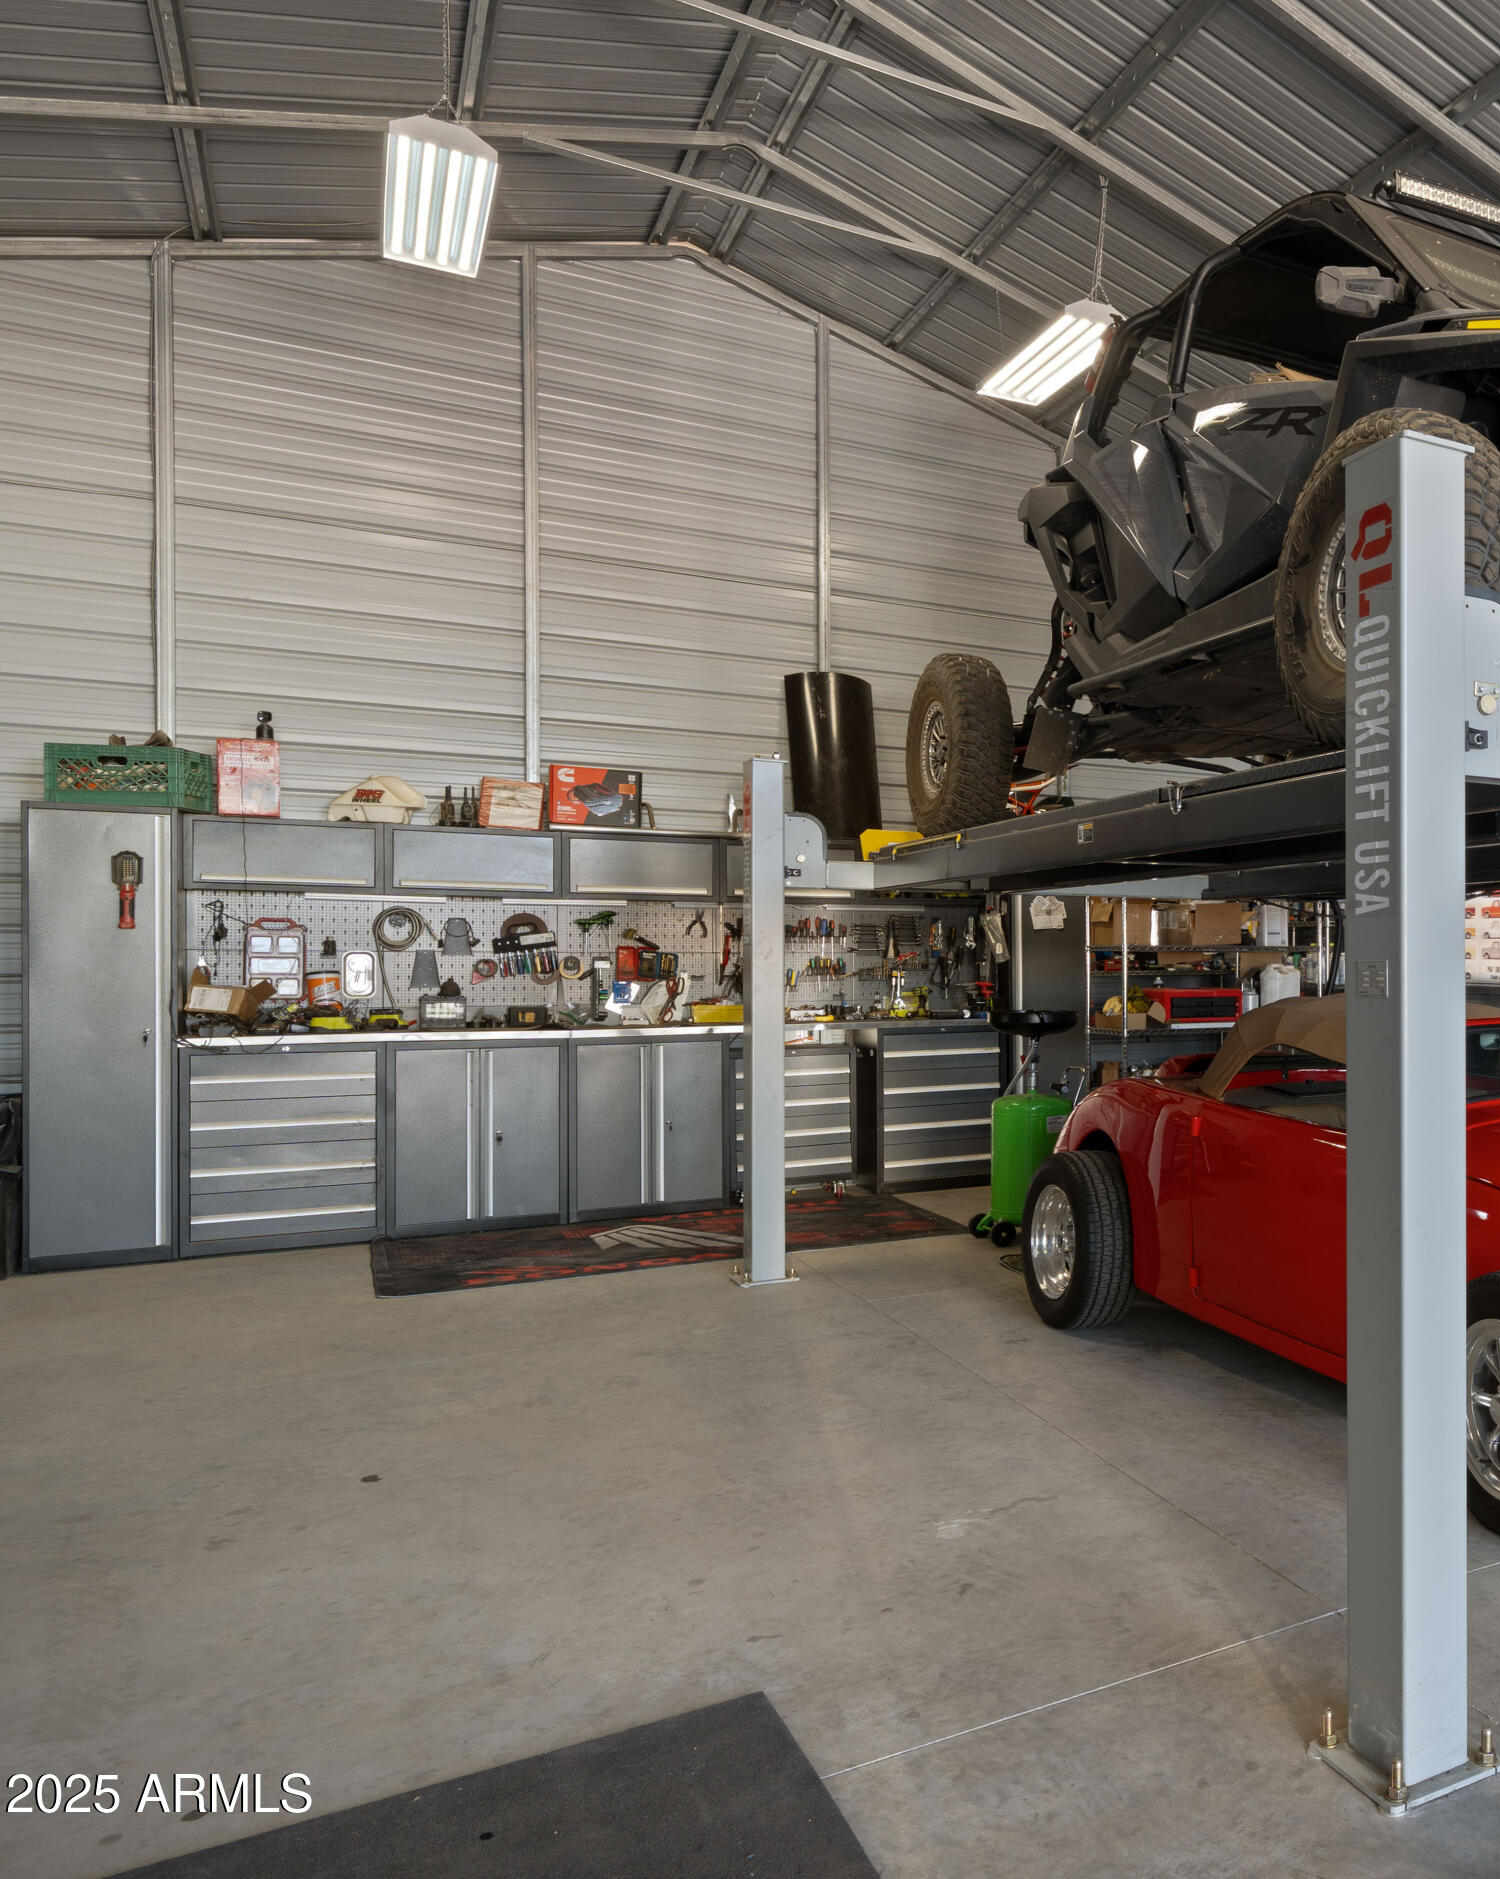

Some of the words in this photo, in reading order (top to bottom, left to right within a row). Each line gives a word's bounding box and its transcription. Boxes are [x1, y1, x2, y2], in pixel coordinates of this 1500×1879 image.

[1350, 501, 1393, 619] QL
[1353, 614, 1391, 823] QUICKLIFT
[1354, 840, 1391, 916] USA
